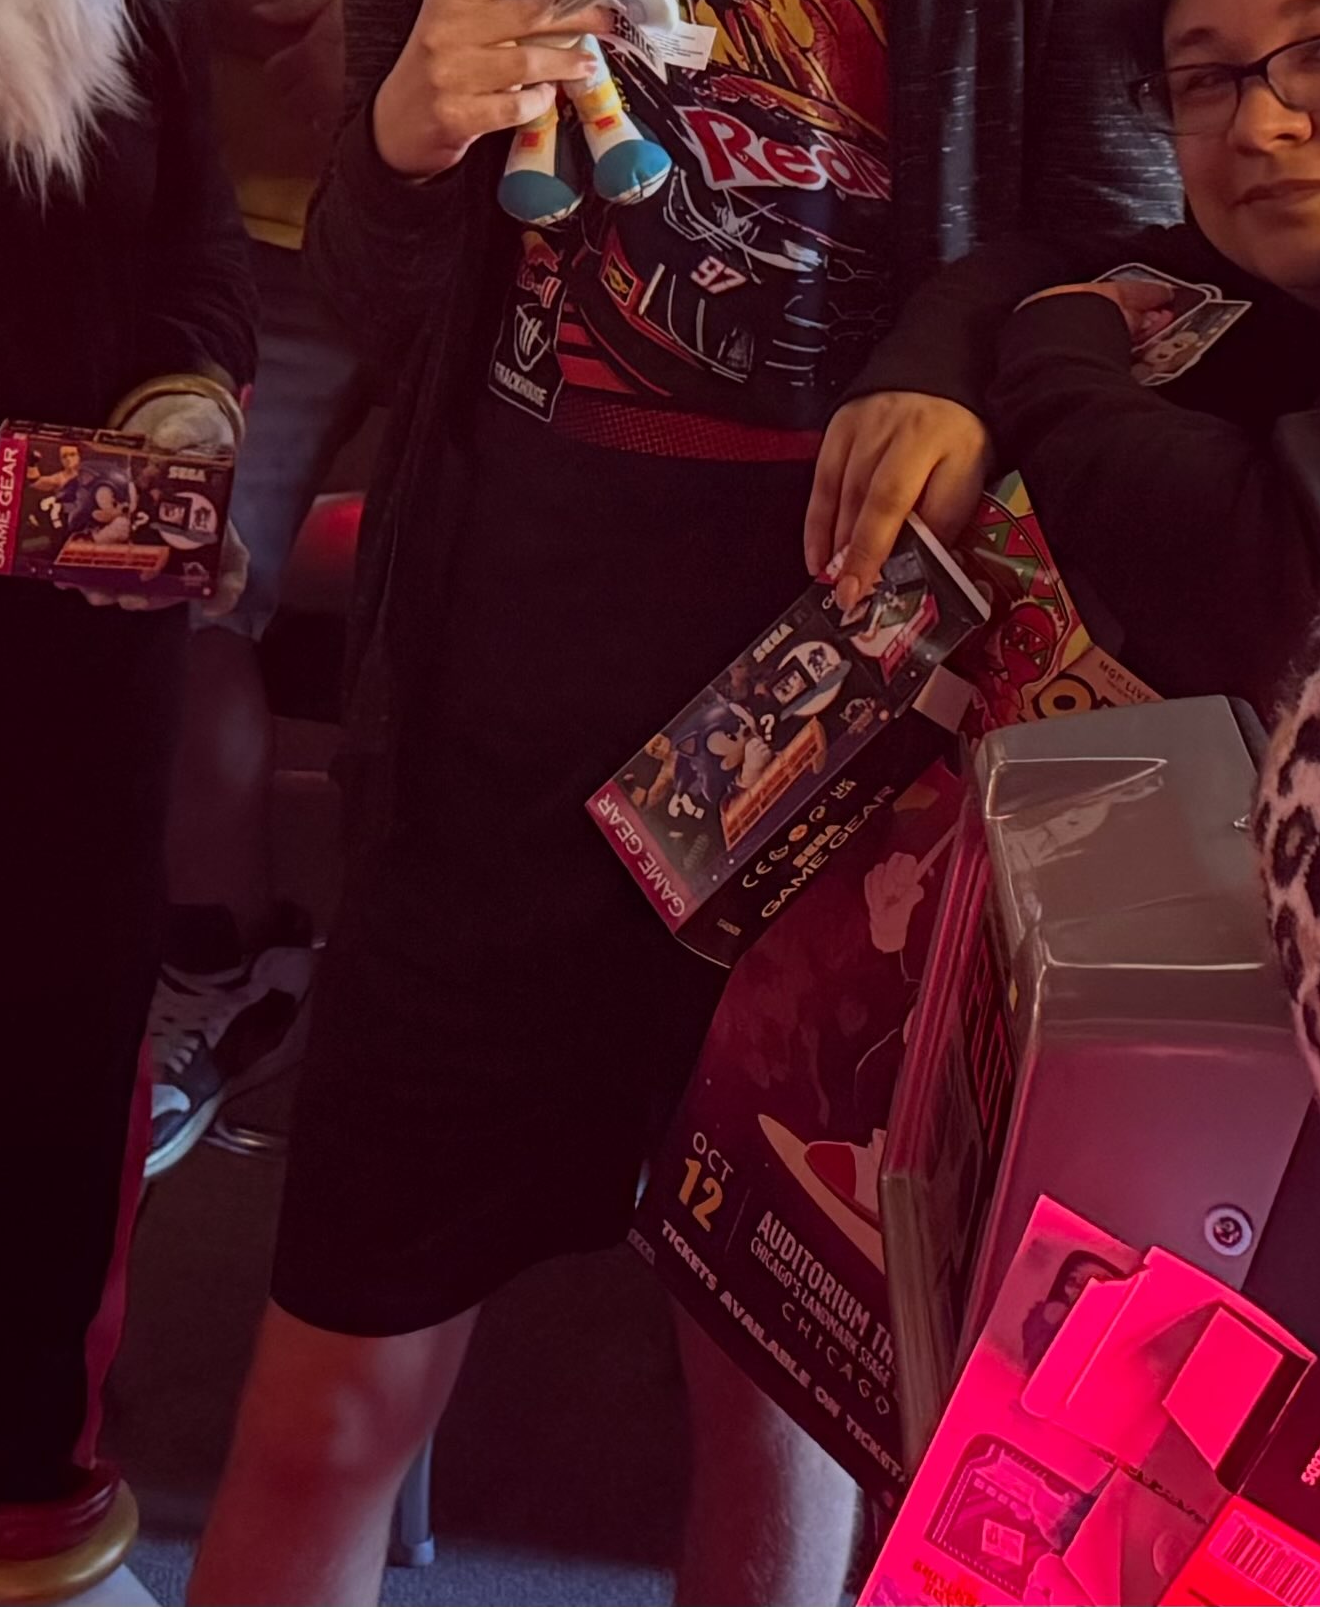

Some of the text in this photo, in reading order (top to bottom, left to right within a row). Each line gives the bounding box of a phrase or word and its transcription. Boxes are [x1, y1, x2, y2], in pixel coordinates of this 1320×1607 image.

[690, 256, 748, 294] 97
[597, 793, 685, 917] GAME GEAR
[761, 851, 829, 918] GAME
[692, 1131, 734, 1183] OCT
[679, 1158, 723, 1232] 12
[756, 1210, 871, 1336] AUDITORIUM
[662, 1219, 718, 1291] TICKETS
[719, 1290, 812, 1389] AVAILABLE
[814, 1385, 841, 1418] ON
